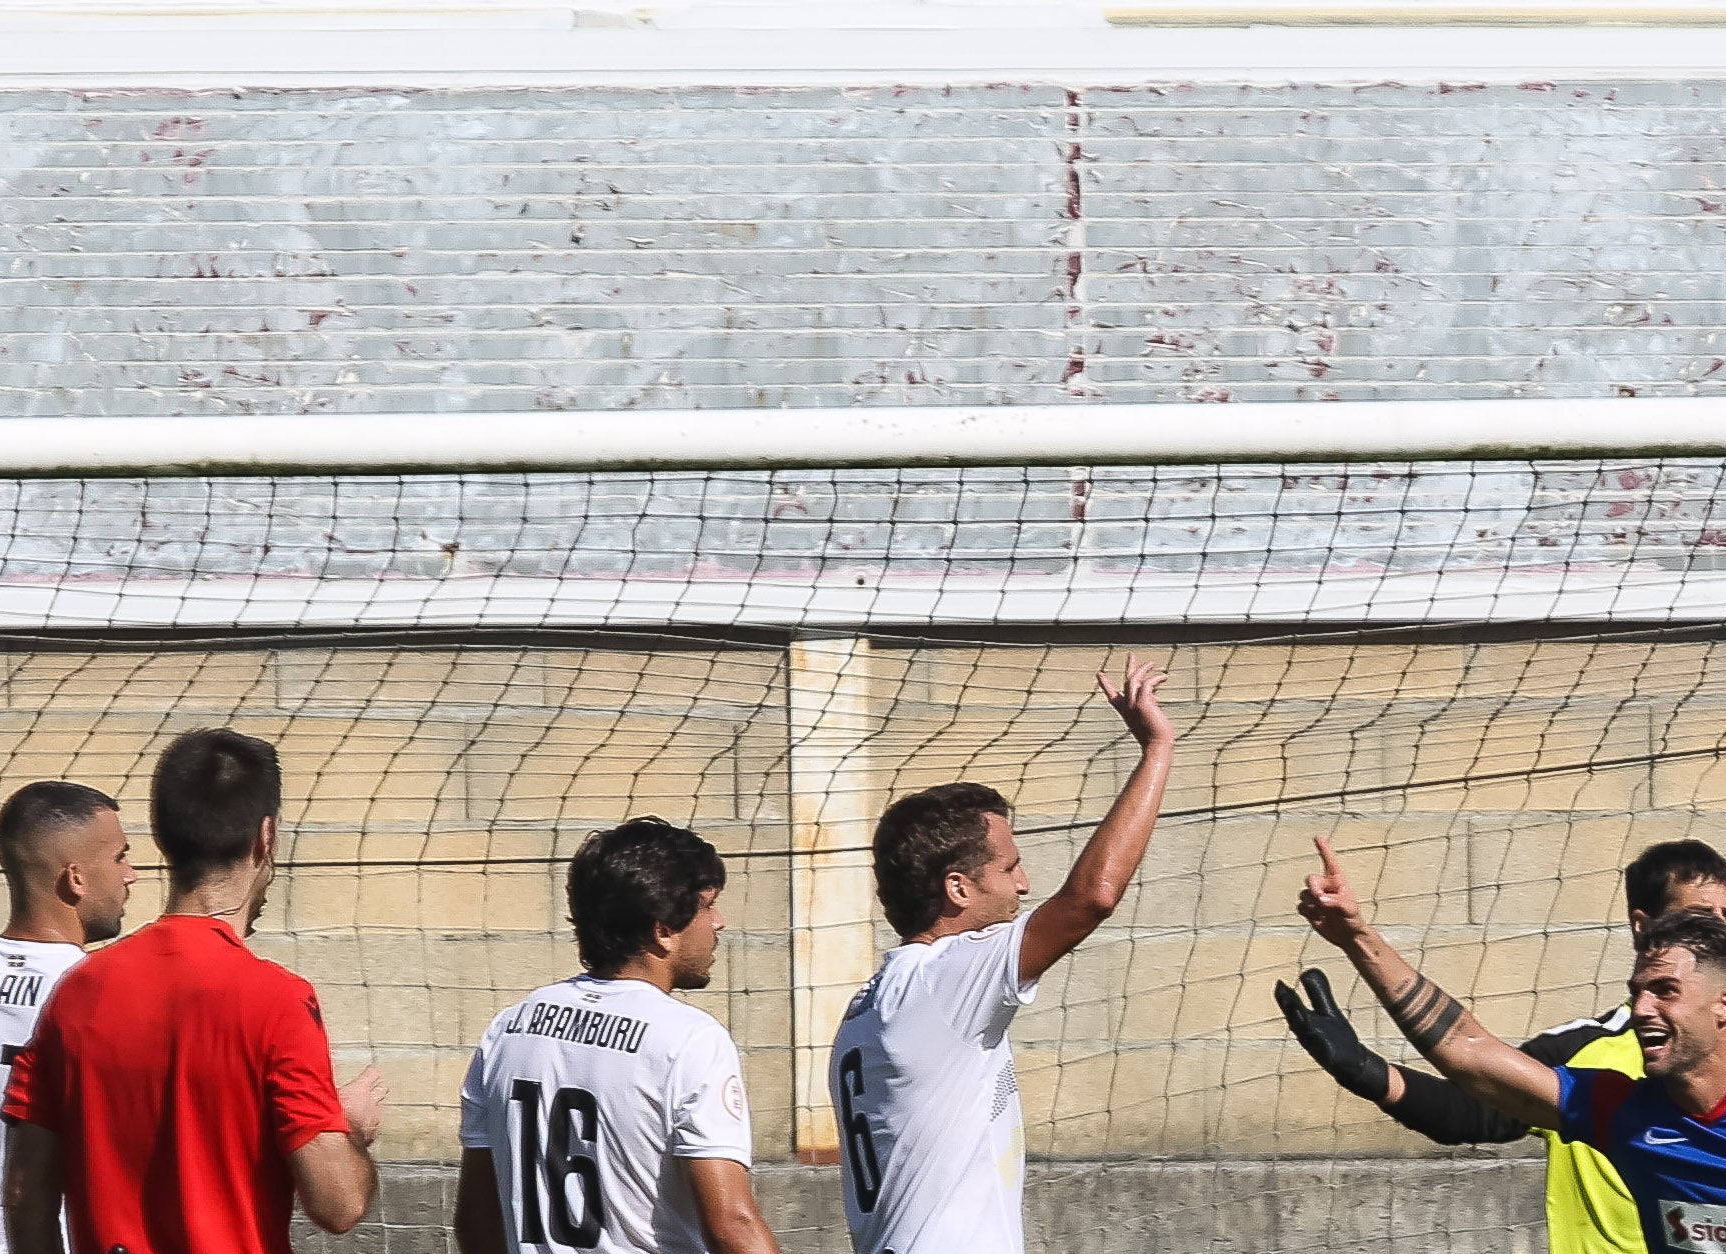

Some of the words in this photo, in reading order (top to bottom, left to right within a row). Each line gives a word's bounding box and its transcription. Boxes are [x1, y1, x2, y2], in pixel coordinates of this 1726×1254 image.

[526, 1001, 649, 1054] ARAMBURU
[510, 1078, 604, 1249] 16
[840, 1047, 881, 1213] 6
